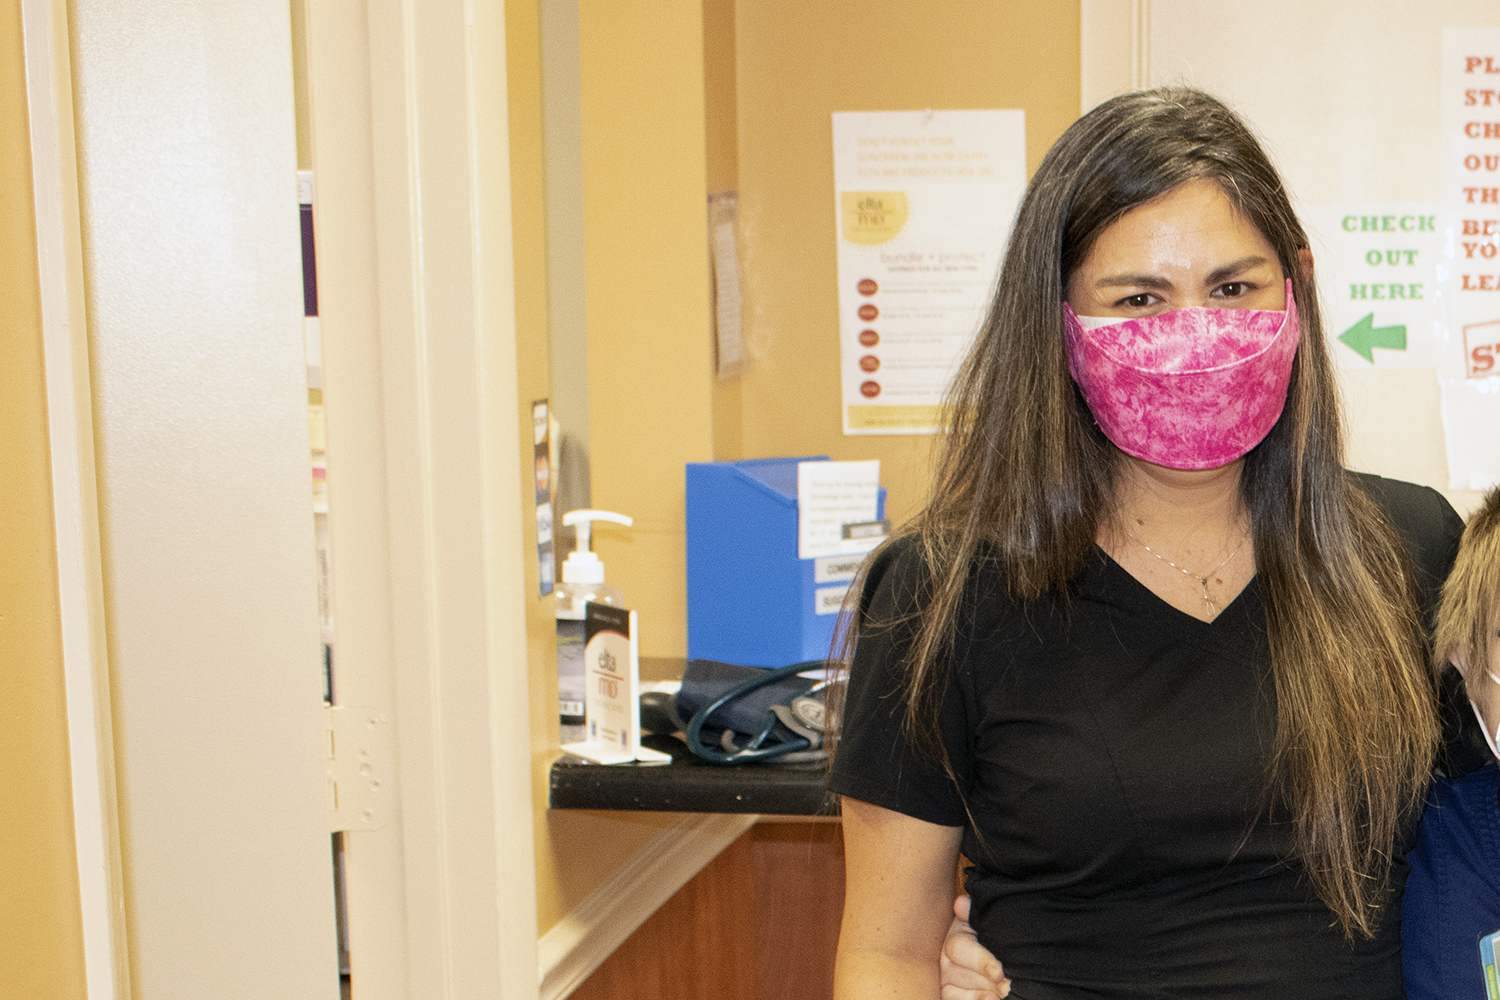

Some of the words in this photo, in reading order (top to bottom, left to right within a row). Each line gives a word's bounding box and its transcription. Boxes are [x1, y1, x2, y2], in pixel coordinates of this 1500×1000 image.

[1341, 215, 1436, 232] CHECK
[1366, 249, 1418, 266] OUT
[1349, 283, 1423, 300] HERE
